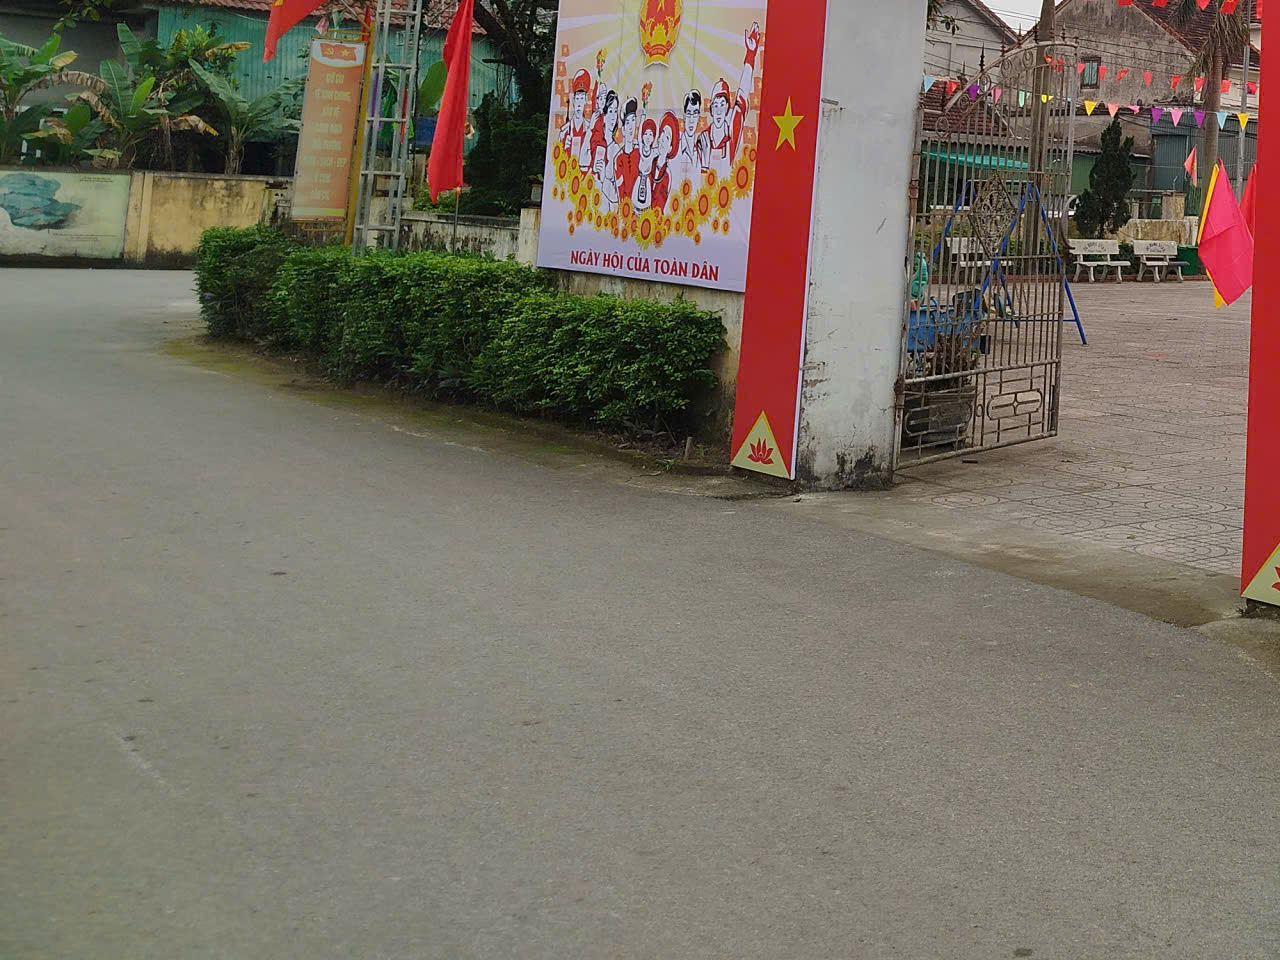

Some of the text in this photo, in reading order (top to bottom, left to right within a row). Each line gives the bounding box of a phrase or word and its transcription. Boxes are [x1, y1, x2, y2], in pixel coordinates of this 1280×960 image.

[570, 248, 719, 281] NGÀY HỘI CỦA TOÀN DÂN
